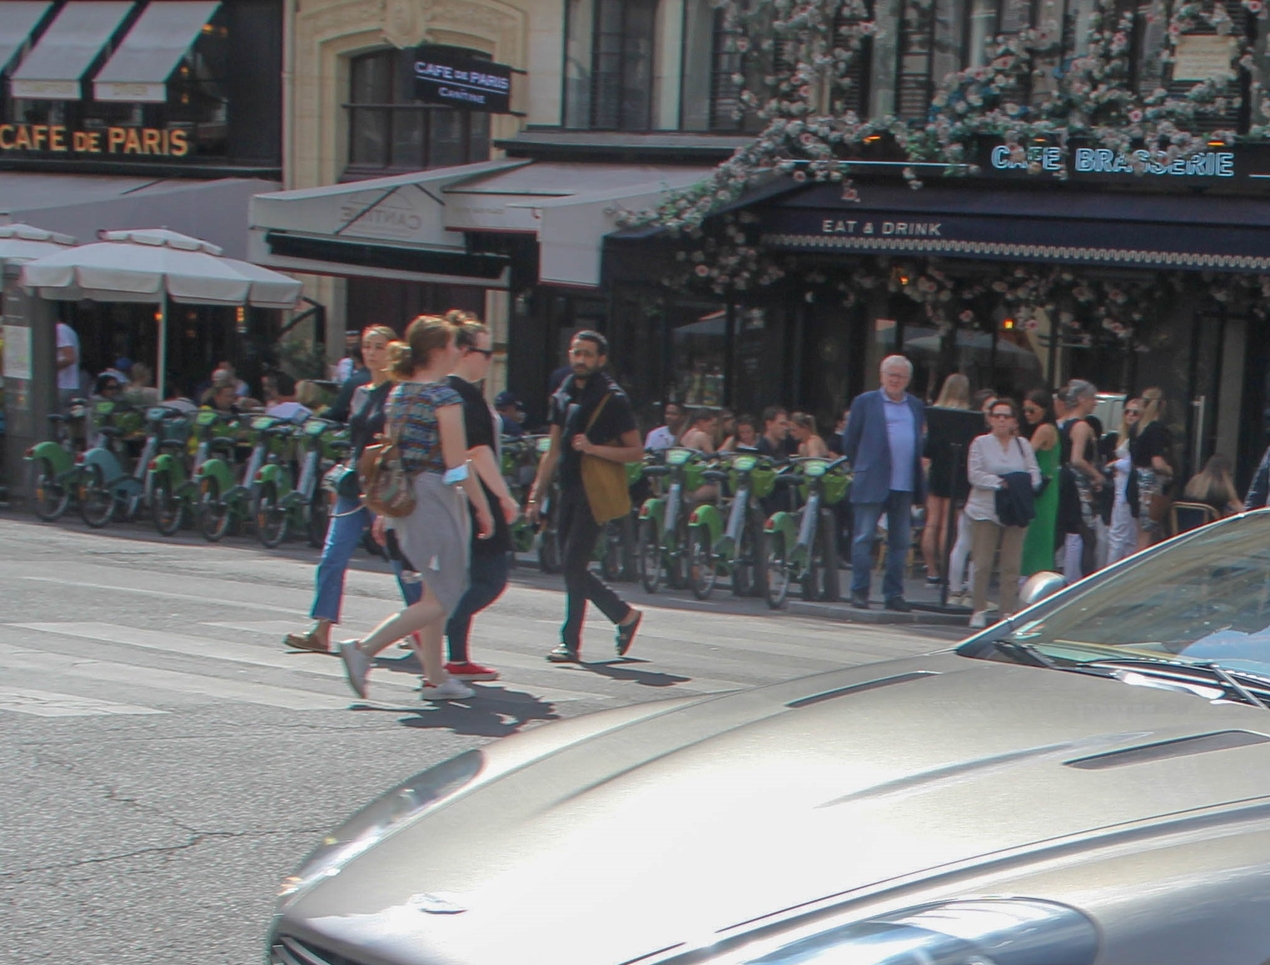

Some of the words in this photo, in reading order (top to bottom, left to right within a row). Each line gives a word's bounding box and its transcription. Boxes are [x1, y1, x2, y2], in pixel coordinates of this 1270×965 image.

[414, 61, 454, 80] CAFE
[469, 71, 509, 89] PARIS
[0, 123, 68, 151] CAFE
[73, 131, 101, 152] DE
[108, 127, 188, 156] PARIS
[822, 220, 857, 233] EAT
[862, 222, 875, 234] &
[881, 222, 941, 236] DRINK
